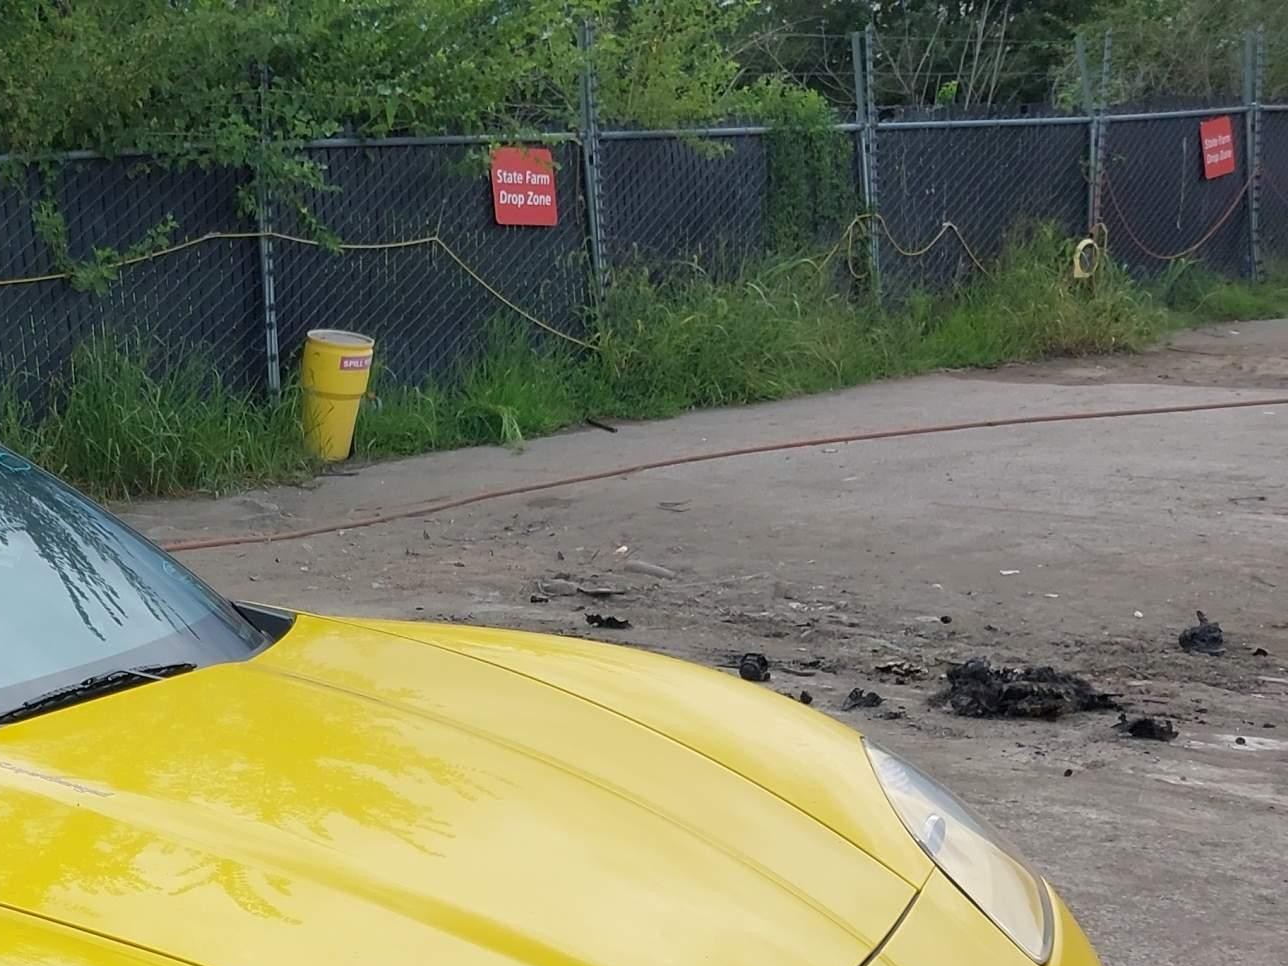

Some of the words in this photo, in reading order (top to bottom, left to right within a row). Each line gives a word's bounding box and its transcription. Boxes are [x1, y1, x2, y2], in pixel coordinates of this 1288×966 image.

[497, 169, 523, 184] State
[525, 171, 550, 185] Farm
[499, 190, 525, 208] Drop
[527, 191, 552, 206] Zone
